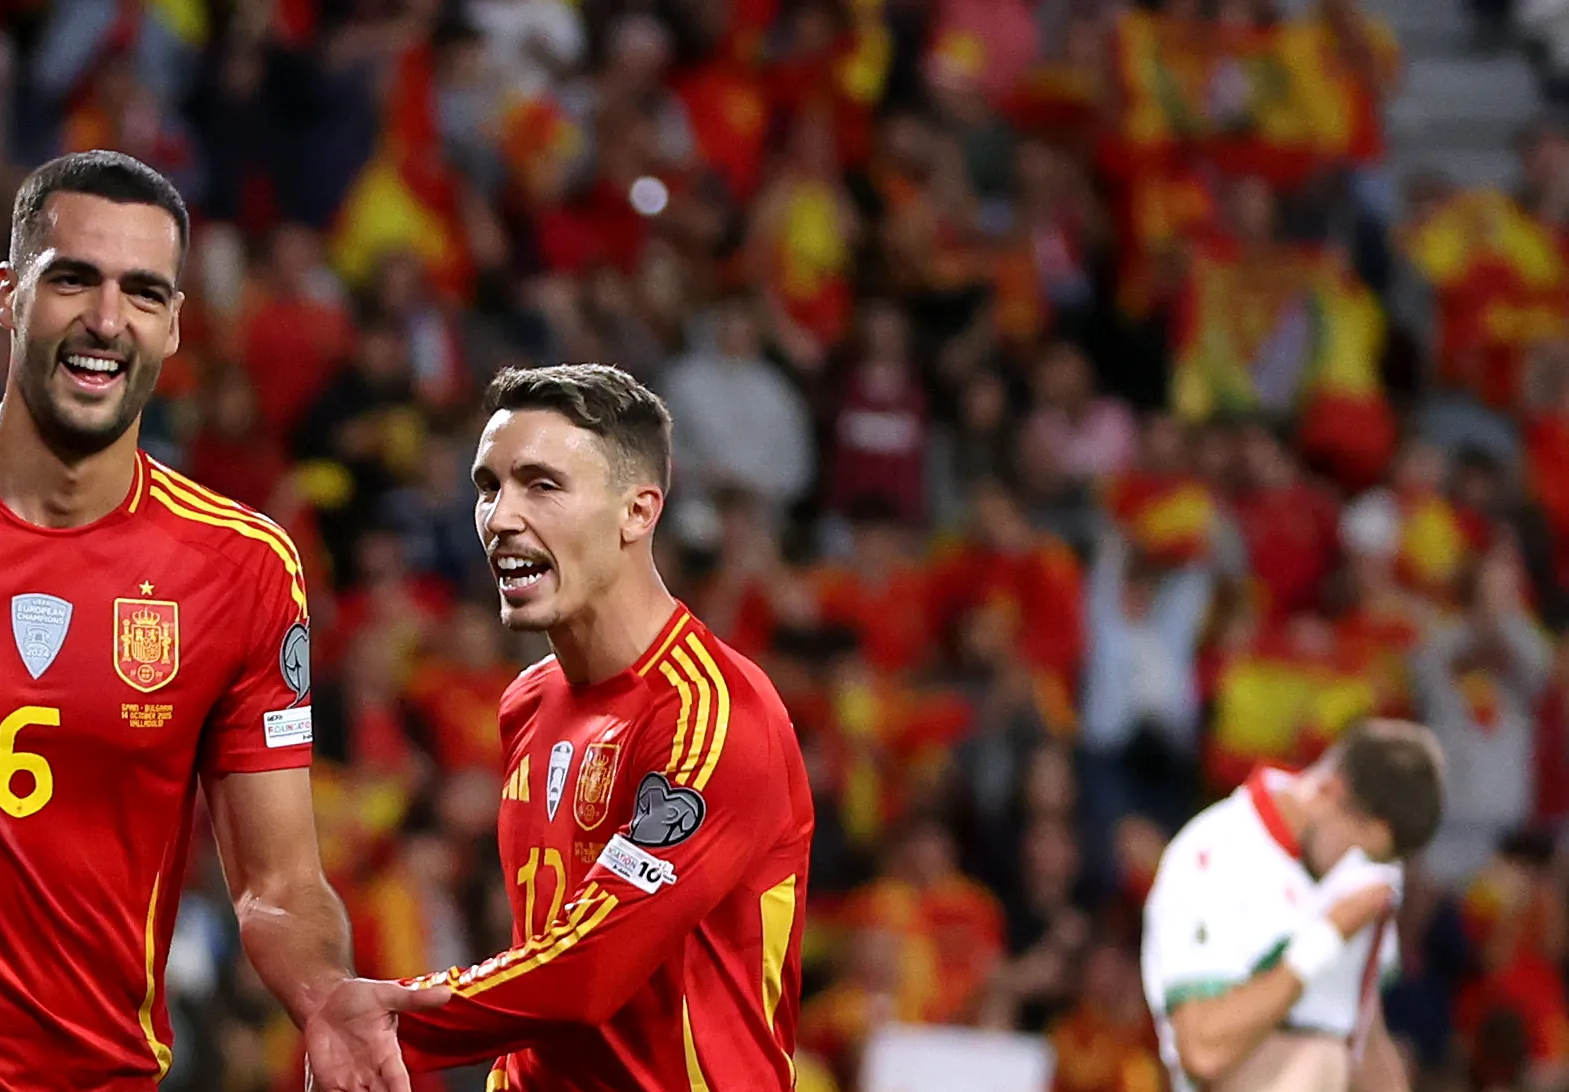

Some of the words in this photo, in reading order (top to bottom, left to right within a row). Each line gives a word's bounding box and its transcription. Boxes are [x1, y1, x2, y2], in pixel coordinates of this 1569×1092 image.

[17, 603, 65, 617] EUROPEAN
[17, 613, 65, 625] CHAMPIONS
[26, 648, 49, 658] 2024
